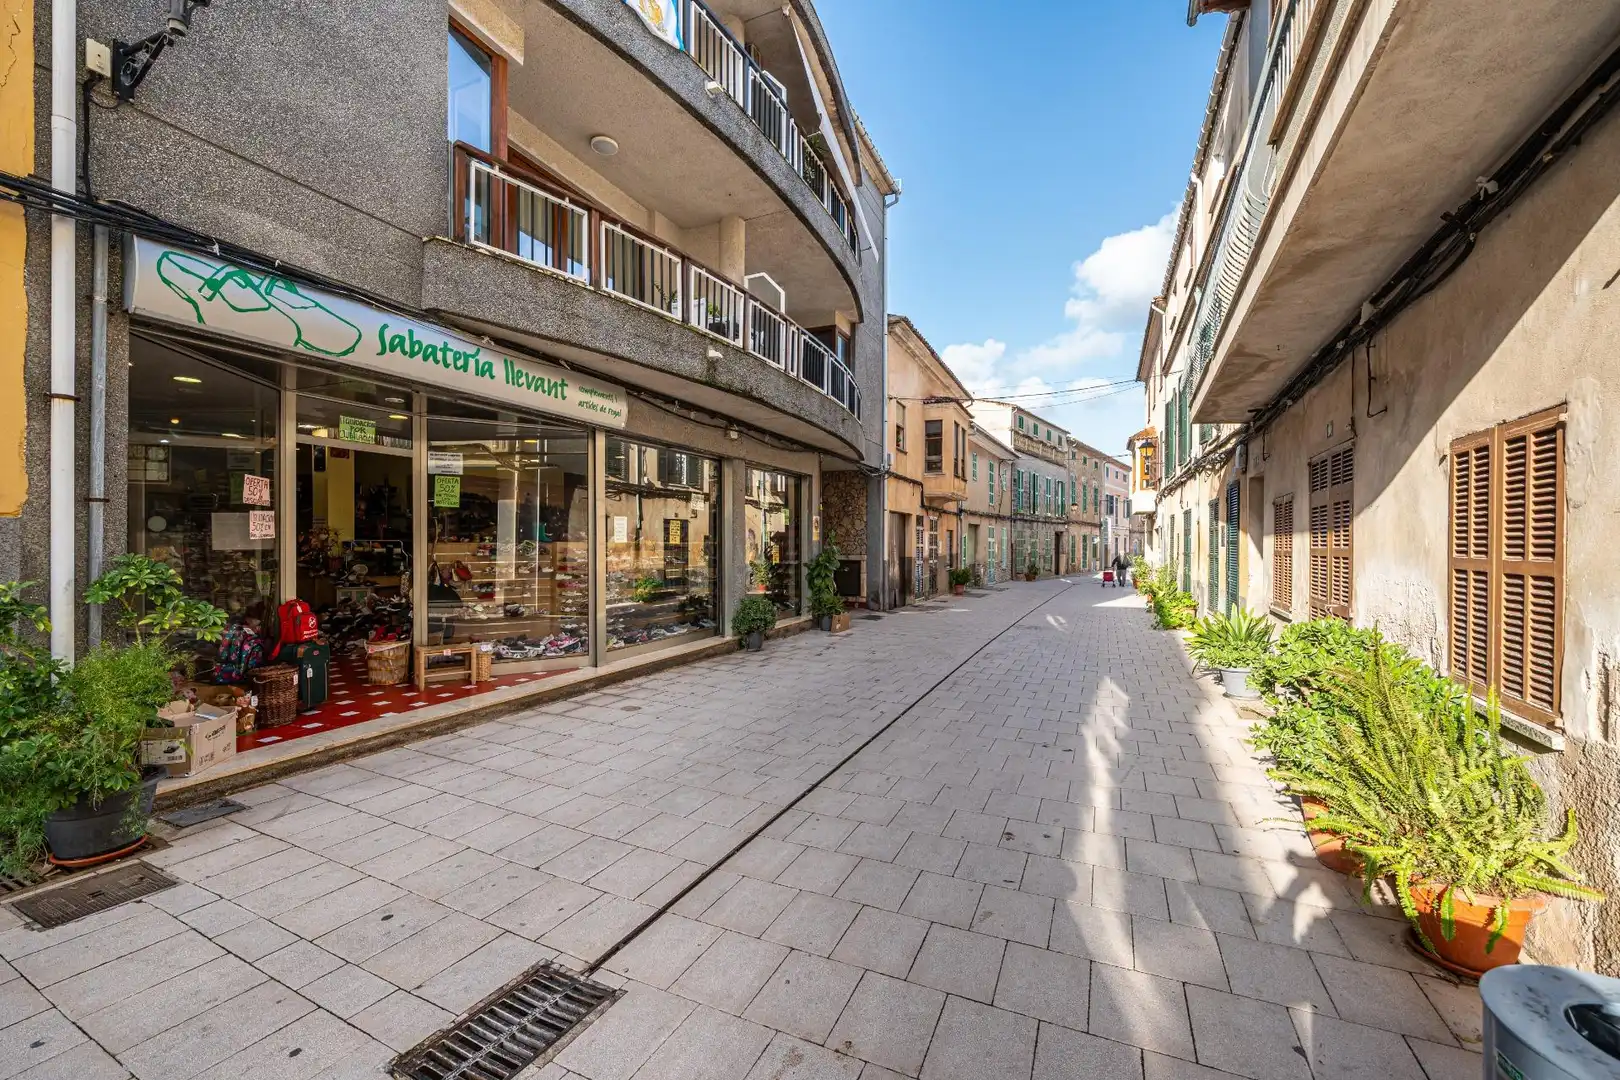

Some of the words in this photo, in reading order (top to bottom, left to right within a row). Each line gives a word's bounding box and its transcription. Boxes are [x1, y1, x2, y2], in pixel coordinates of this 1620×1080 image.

[376, 323, 496, 380] Sabatería
[503, 357, 569, 401] llevant
[350, 425, 366, 435] POR
[245, 477, 269, 489] OFERTA
[437, 477, 459, 485] OFERTA
[439, 484, 457, 493] 50%
